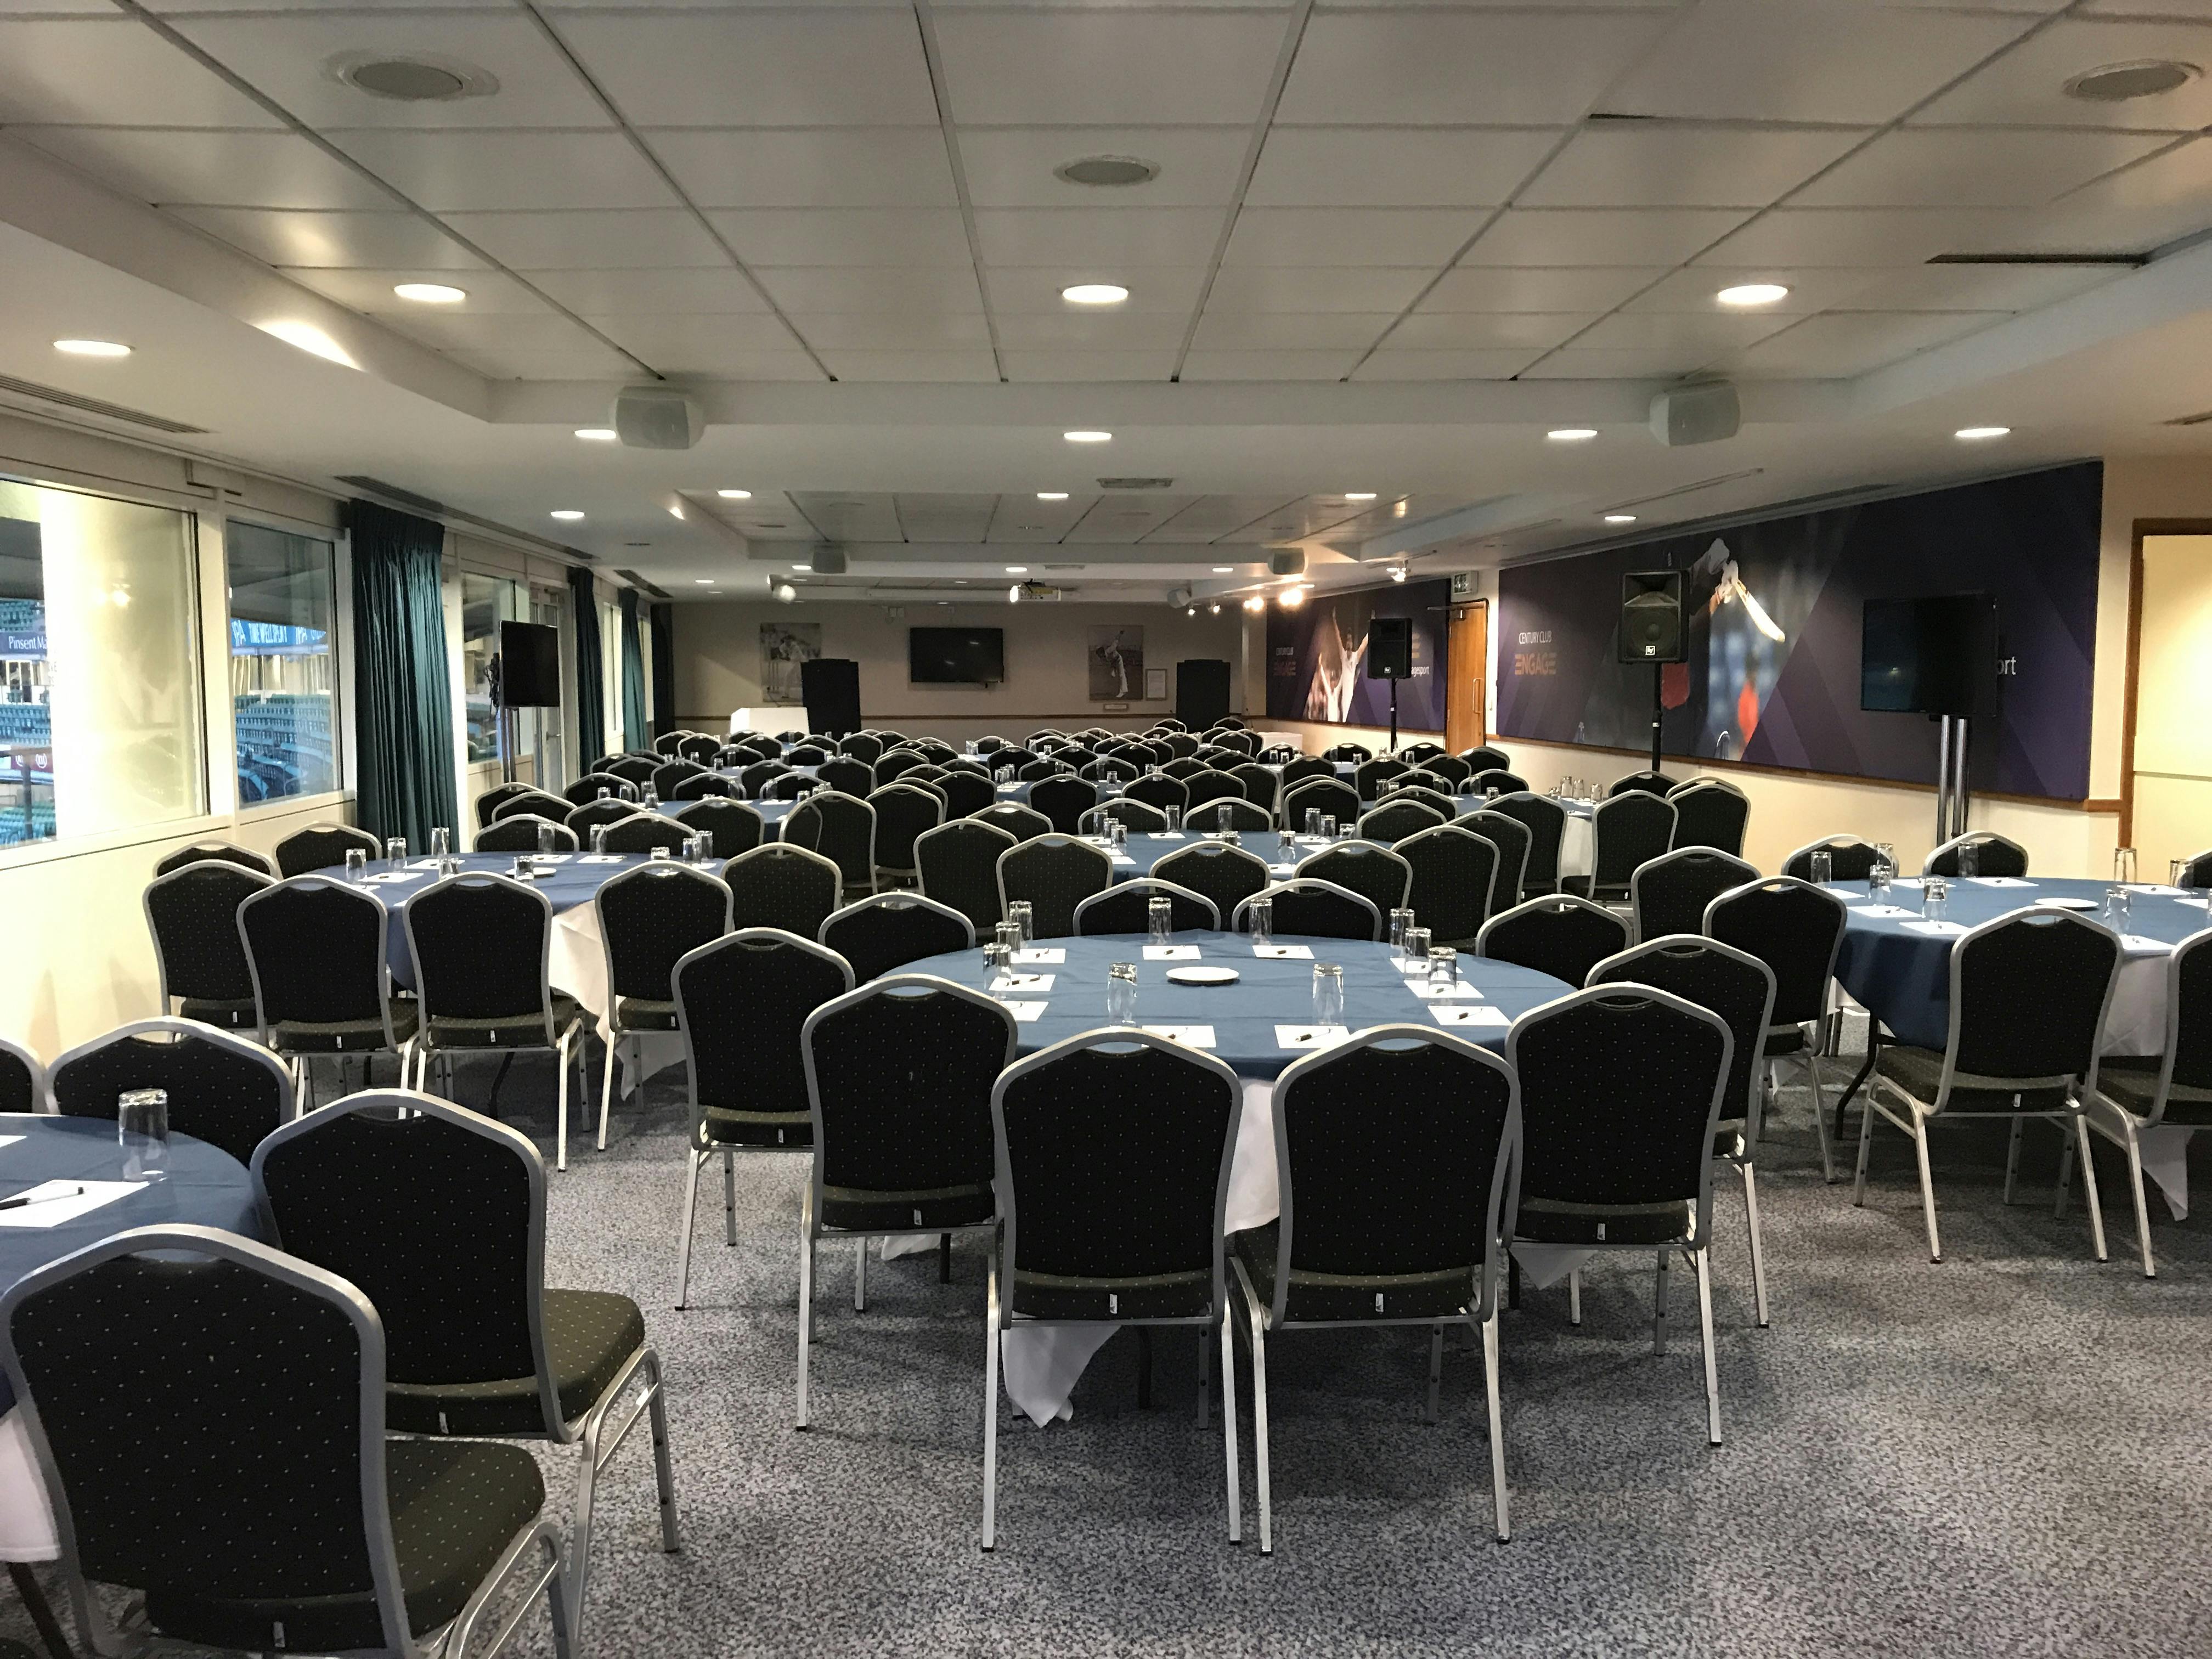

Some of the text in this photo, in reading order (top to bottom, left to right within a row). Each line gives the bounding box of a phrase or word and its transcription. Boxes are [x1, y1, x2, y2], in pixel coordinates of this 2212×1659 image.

[9, 636, 37, 650] Pinsent
[1519, 630, 1552, 644] CENTURY CLUB
[1515, 652, 1556, 675] ENGAGE
[1997, 656, 2017, 675] ort
[1412, 666, 1430, 678] agesport
